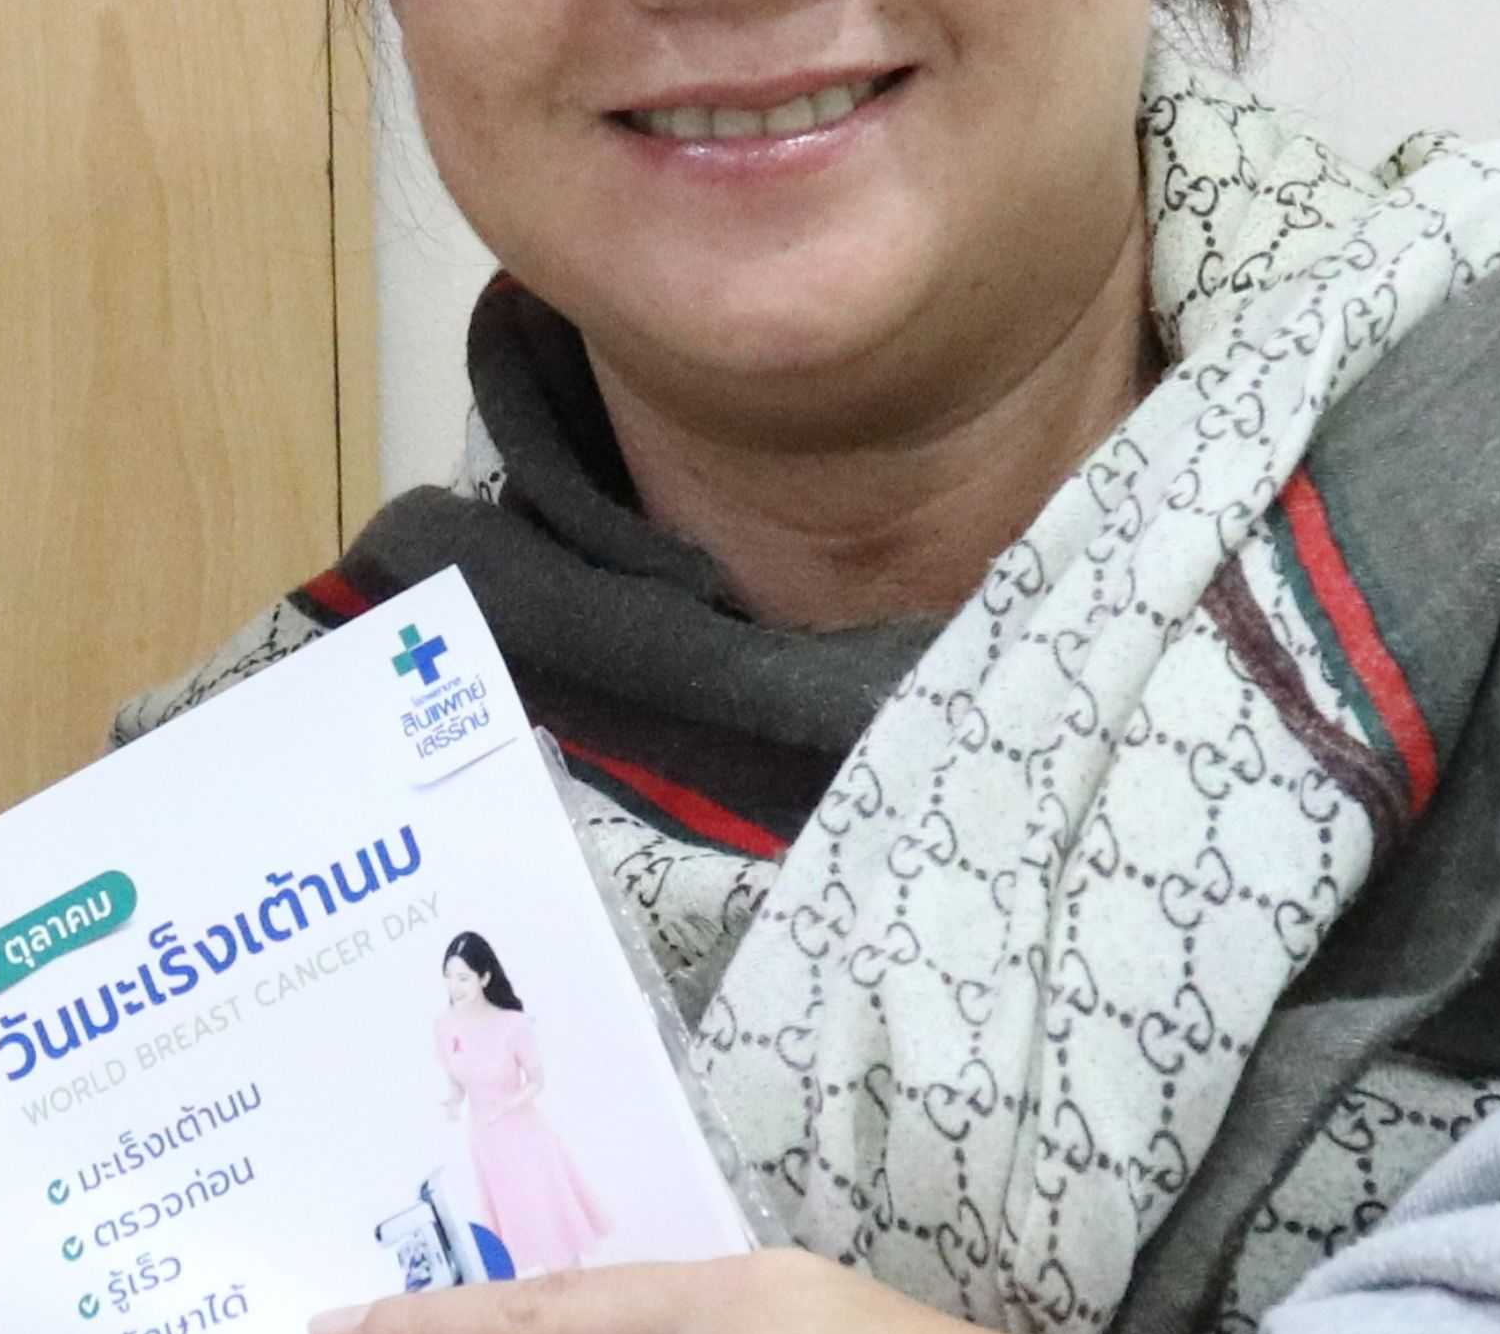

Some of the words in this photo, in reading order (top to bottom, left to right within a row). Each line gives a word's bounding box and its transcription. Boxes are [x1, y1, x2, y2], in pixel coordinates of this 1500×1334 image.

[4, 890, 113, 968] ตุลาคม
[21, 1058, 127, 1128] WORLD
[134, 996, 243, 1072] BREAST
[254, 929, 375, 1008] CANCER
[384, 892, 441, 942] DAY
[77, 1082, 262, 1192] มะเร็งเต้านม
[94, 1157, 255, 1247] ตรวจก่อน
[107, 1252, 182, 1314] รู้เร็ว
